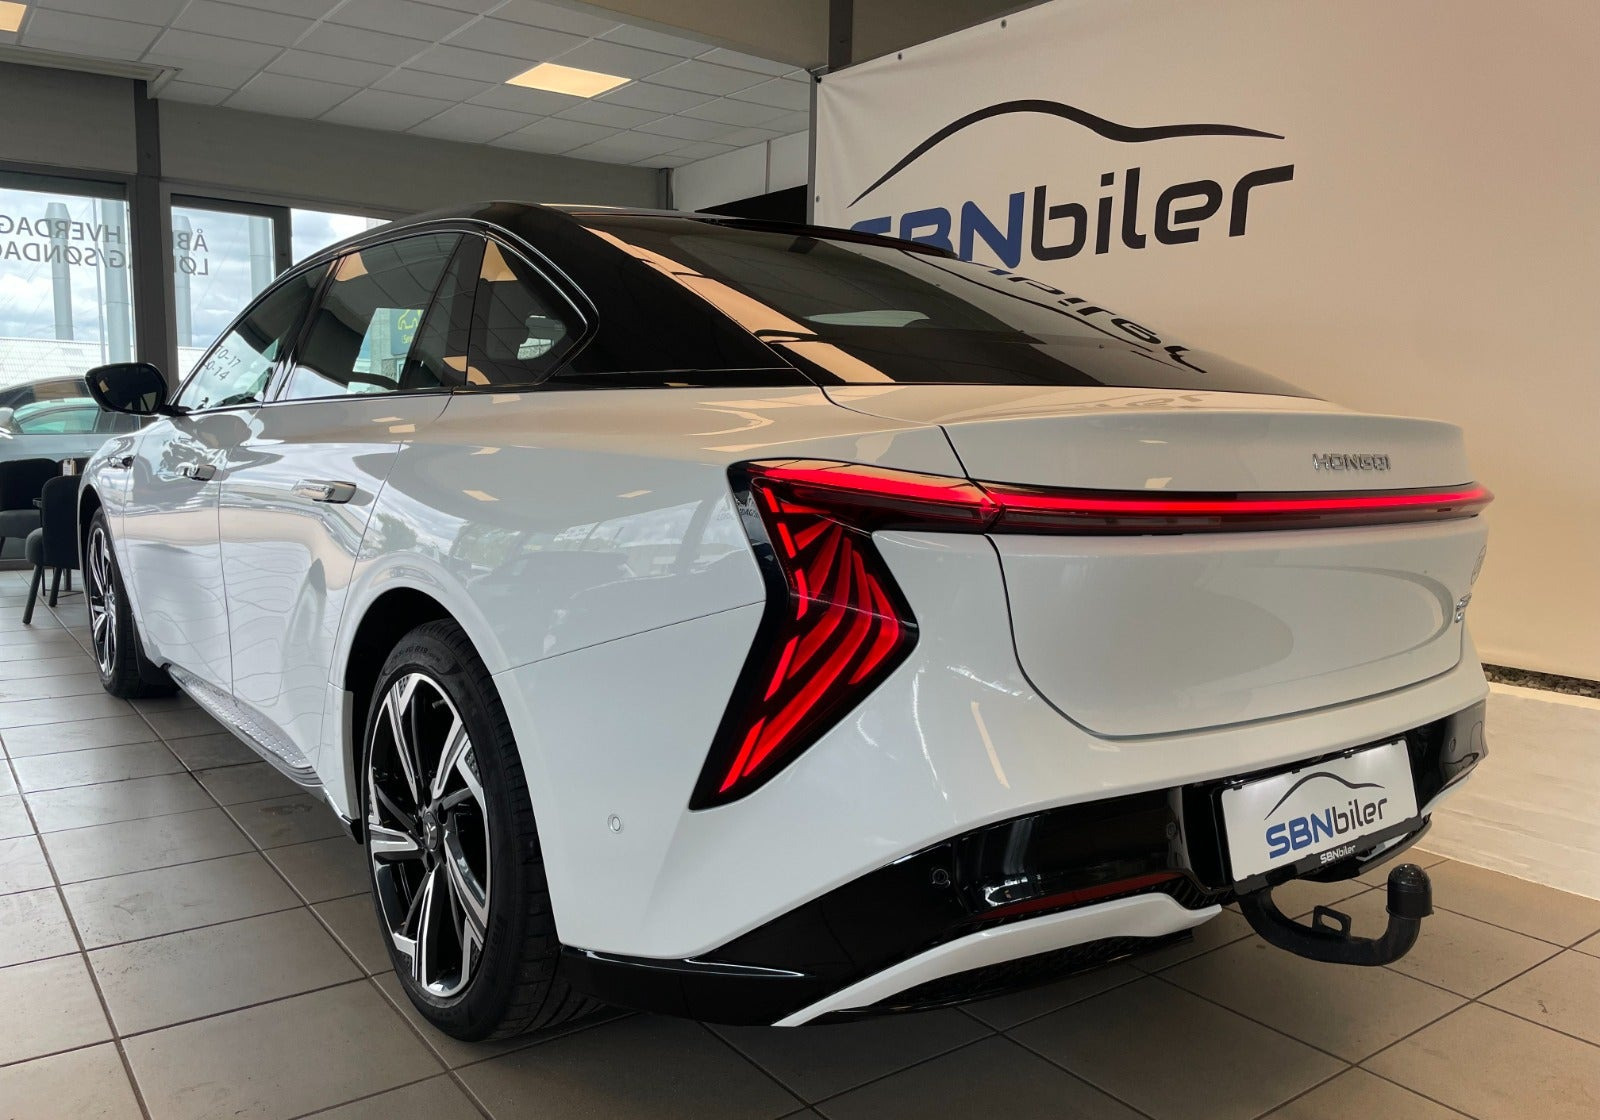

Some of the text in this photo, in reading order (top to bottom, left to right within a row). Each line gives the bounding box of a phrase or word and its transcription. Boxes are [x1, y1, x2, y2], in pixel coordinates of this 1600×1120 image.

[1312, 453, 1391, 471] HONGQI
[1266, 799, 1387, 859] SBNbiler
[1319, 845, 1356, 864] SBNbiler
